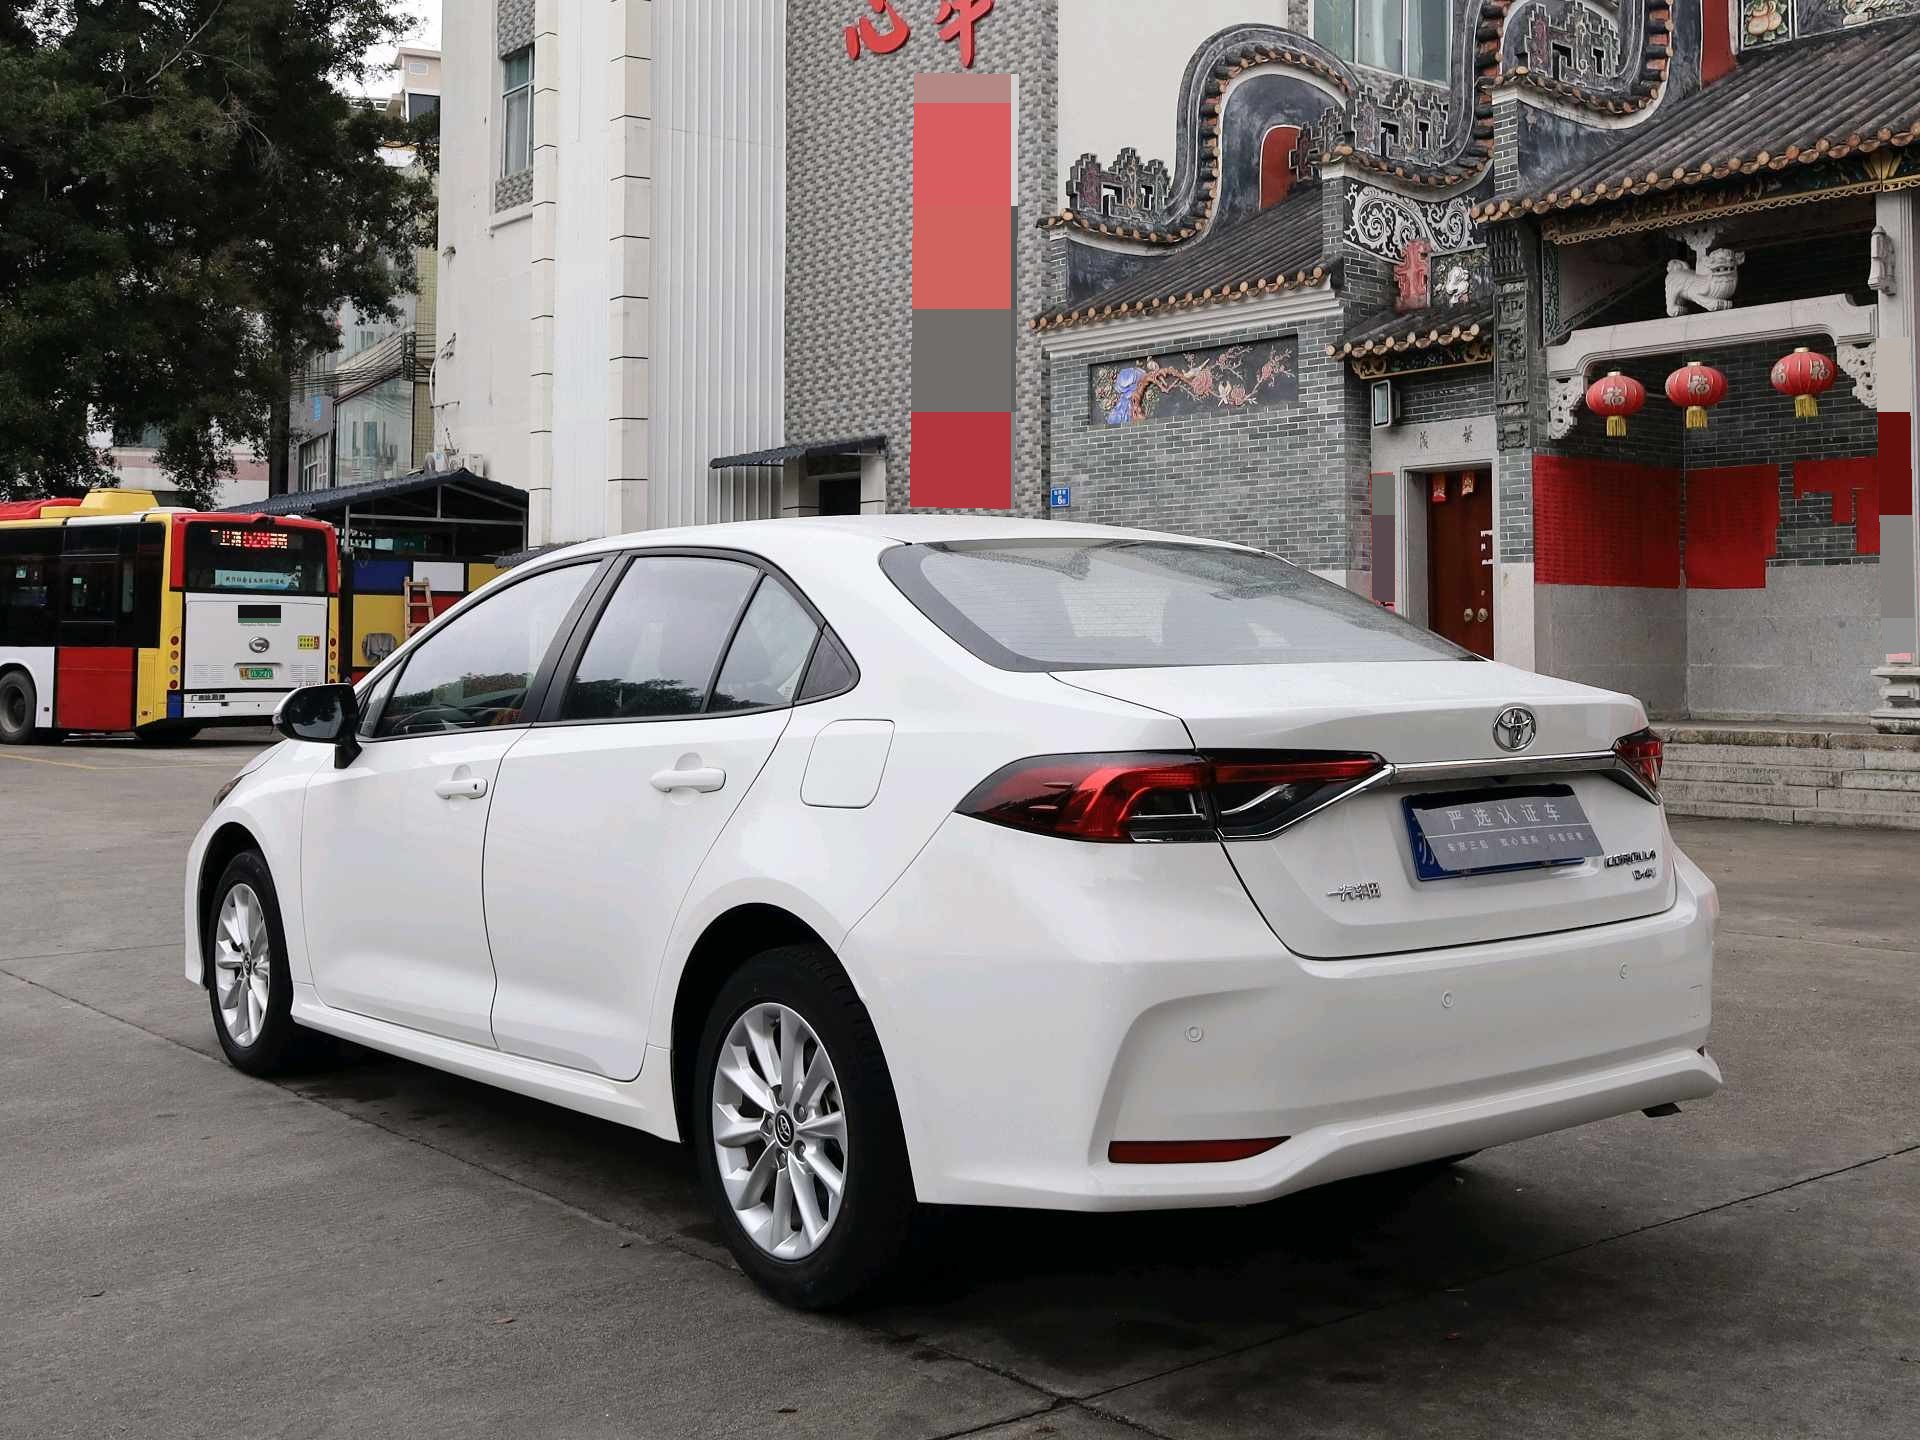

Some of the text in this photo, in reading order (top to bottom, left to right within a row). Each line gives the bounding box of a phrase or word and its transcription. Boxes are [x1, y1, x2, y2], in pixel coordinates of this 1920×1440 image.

[1811, 360, 1831, 382] 福
[1688, 374, 1710, 395] 福
[1602, 386, 1626, 406] 福
[1445, 801, 1561, 831] 严选认证车
[1604, 848, 1657, 869] COROLLA
